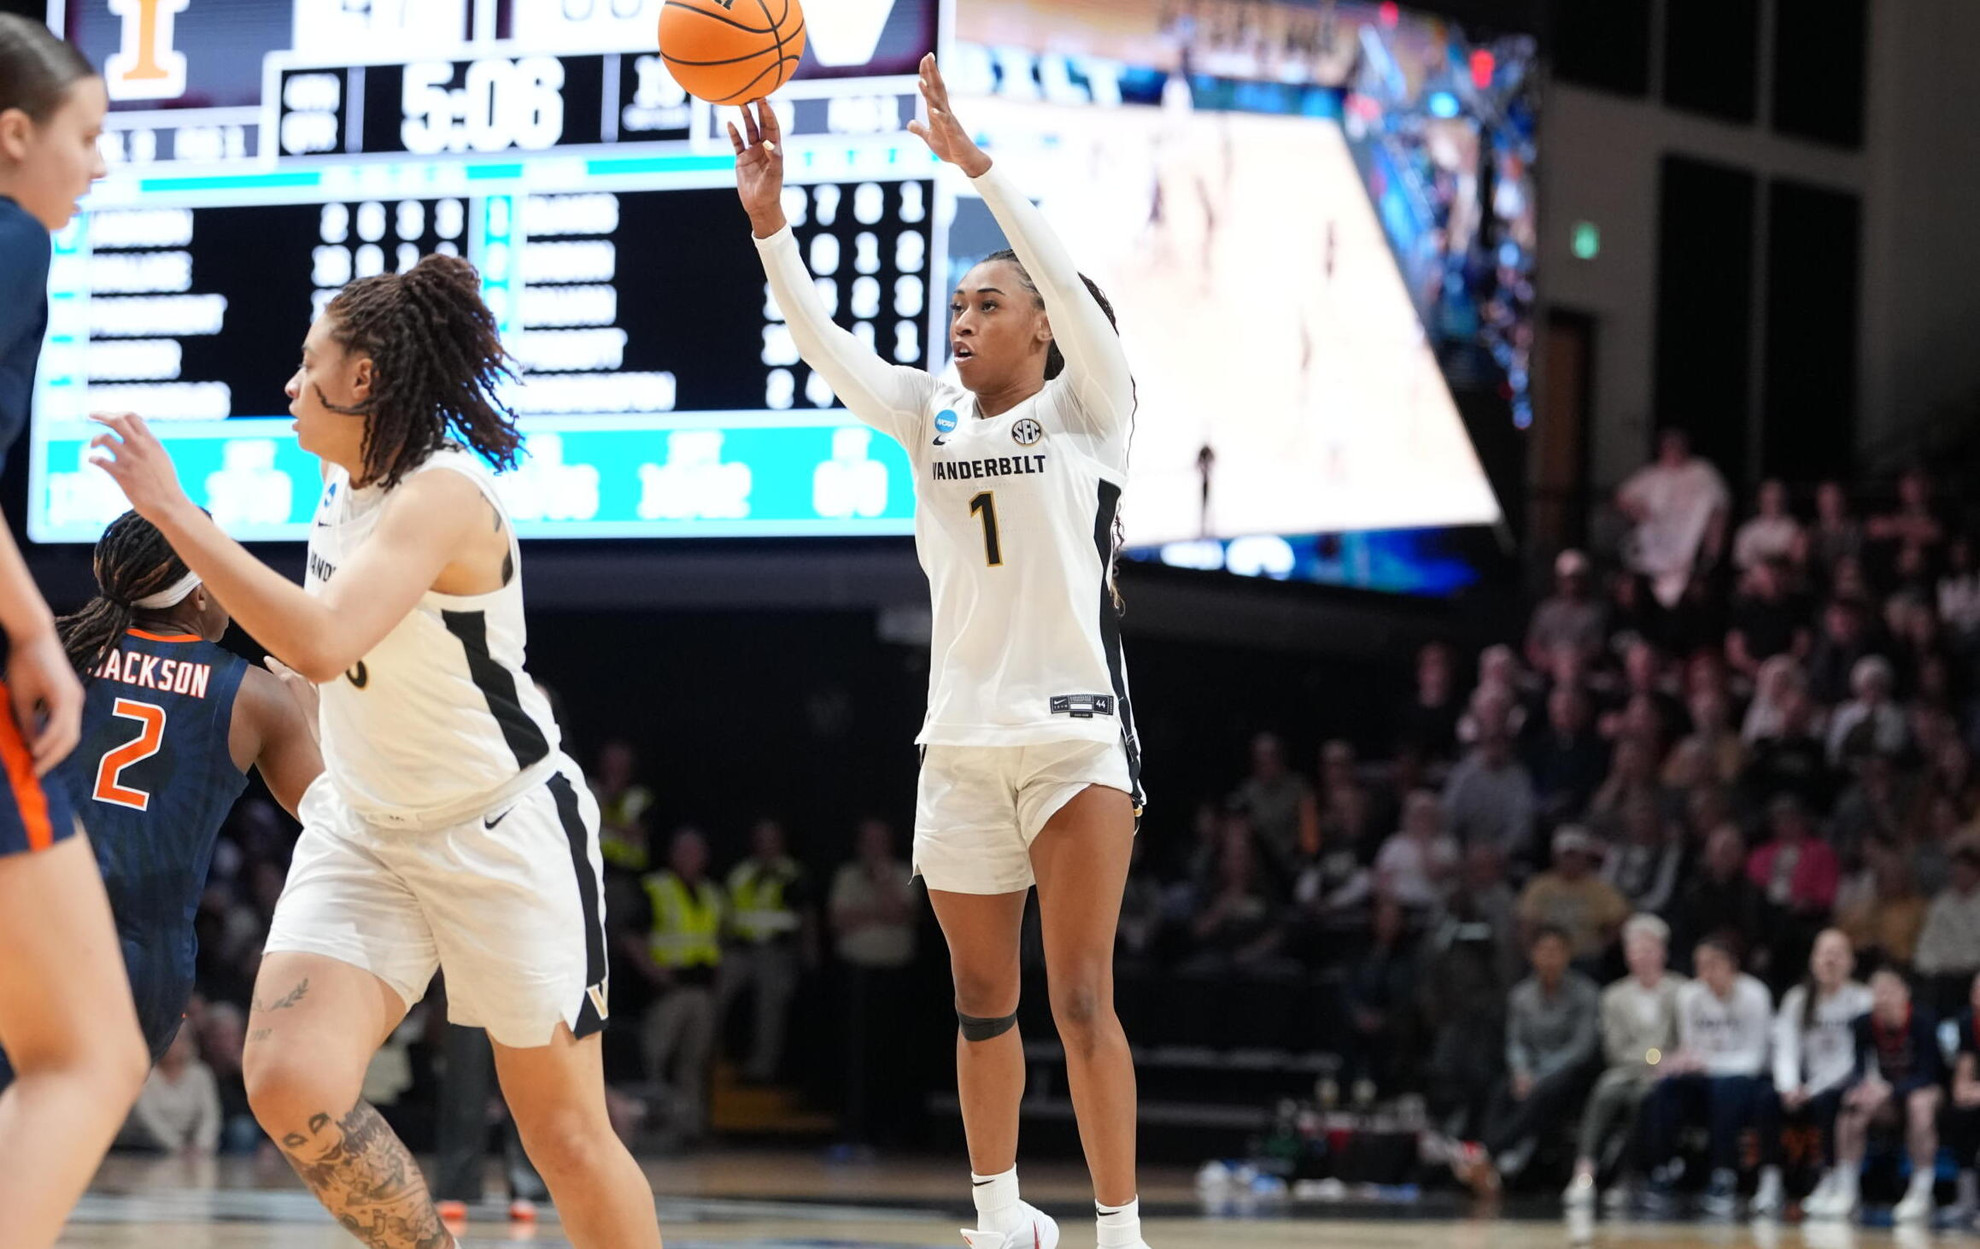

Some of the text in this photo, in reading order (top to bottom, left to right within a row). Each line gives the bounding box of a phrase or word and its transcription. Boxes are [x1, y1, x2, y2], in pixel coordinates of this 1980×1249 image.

[400, 55, 566, 154] 5:06
[1012, 418, 1041, 445] SEC
[932, 455, 1046, 480] VANDERBILT
[969, 490, 1003, 568] 1
[1095, 699, 1106, 709] 44
[92, 697, 167, 812] 2
